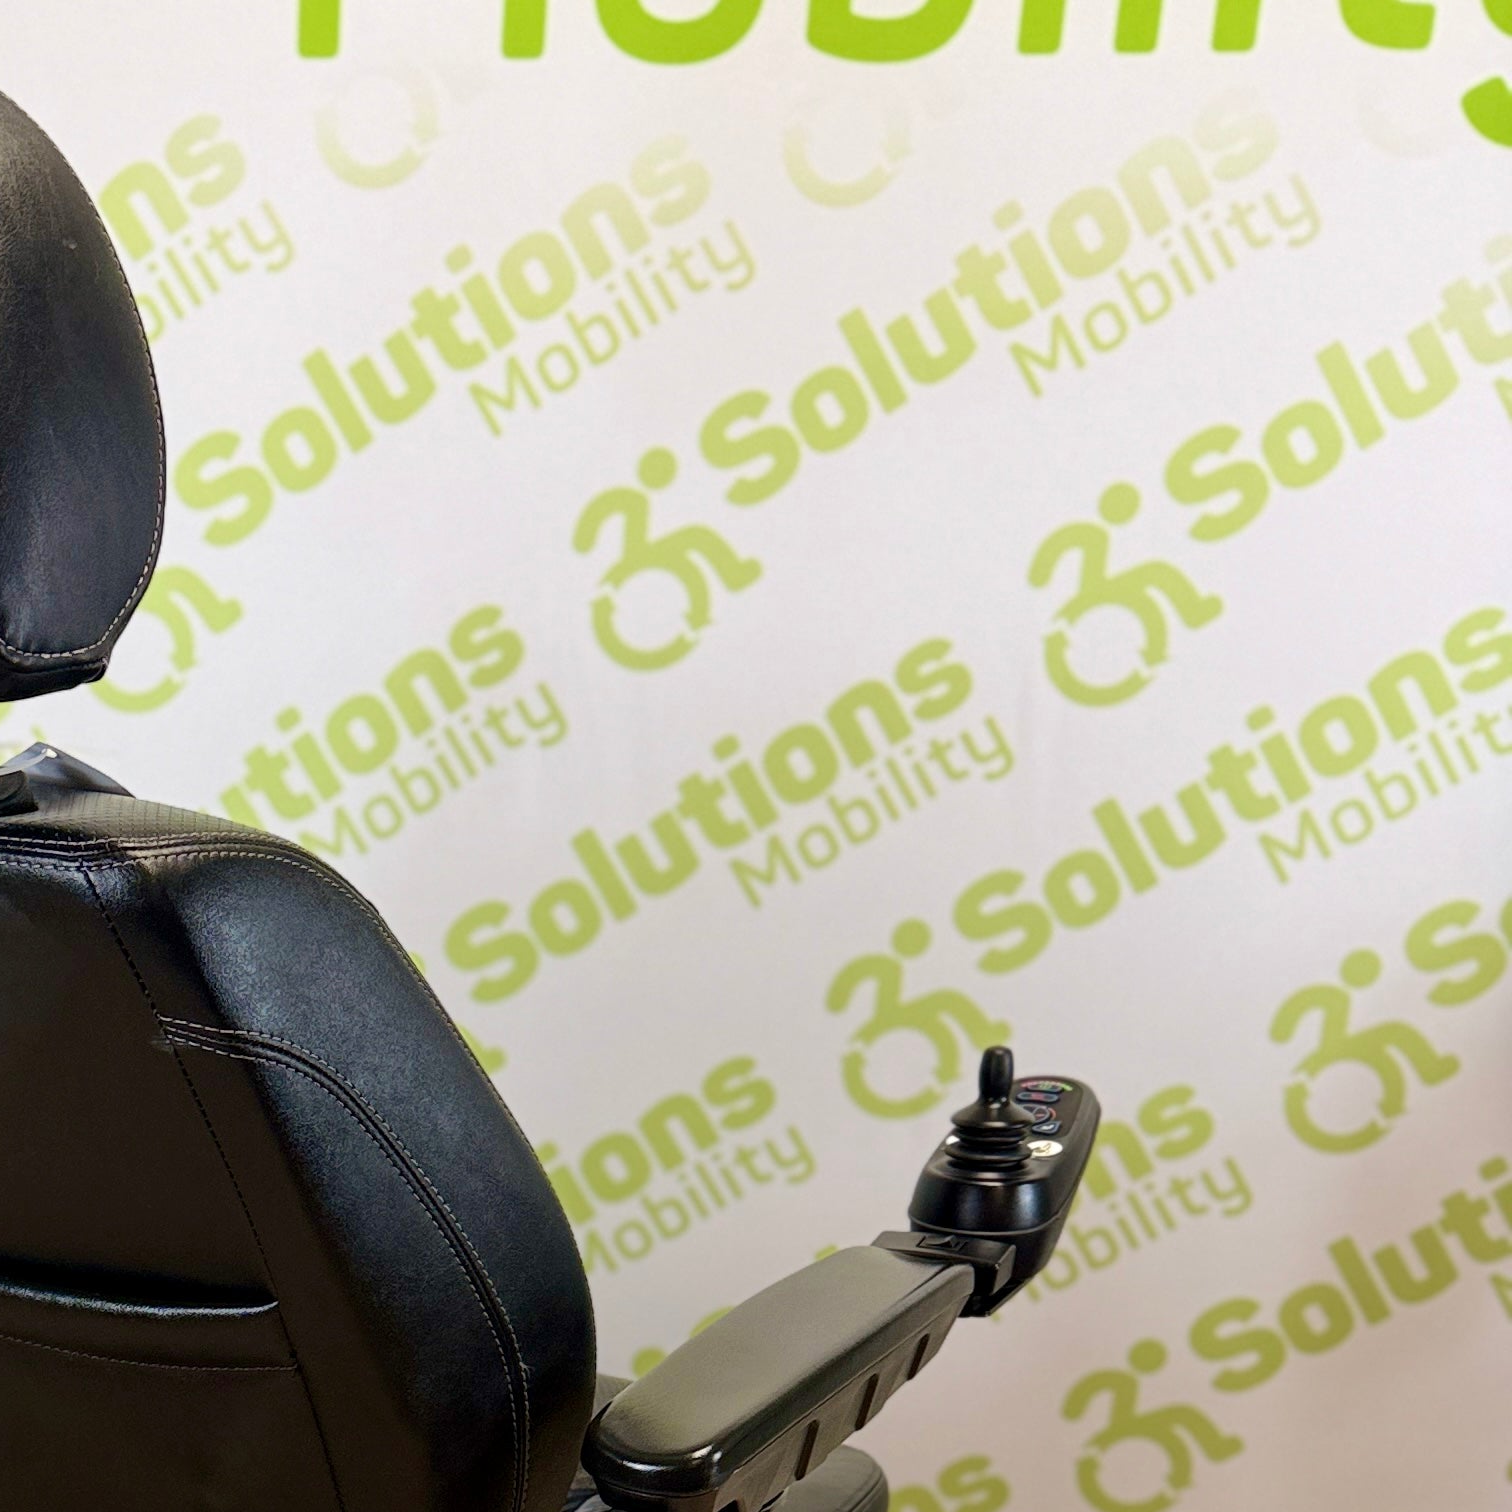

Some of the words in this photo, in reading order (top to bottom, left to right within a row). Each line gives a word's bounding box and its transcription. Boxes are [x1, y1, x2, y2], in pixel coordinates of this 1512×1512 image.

[174, 131, 712, 548] Solutions
[468, 219, 758, 437] Mobility
[699, 86, 1279, 506] Solutions
[1008, 172, 1322, 398] Mobility
[299, 682, 569, 857] Mobility
[445, 637, 974, 1003] Solutions
[729, 716, 1015, 909] Mobility
[953, 605, 1512, 975] Solutions
[1258, 706, 1512, 886] Mobilit
